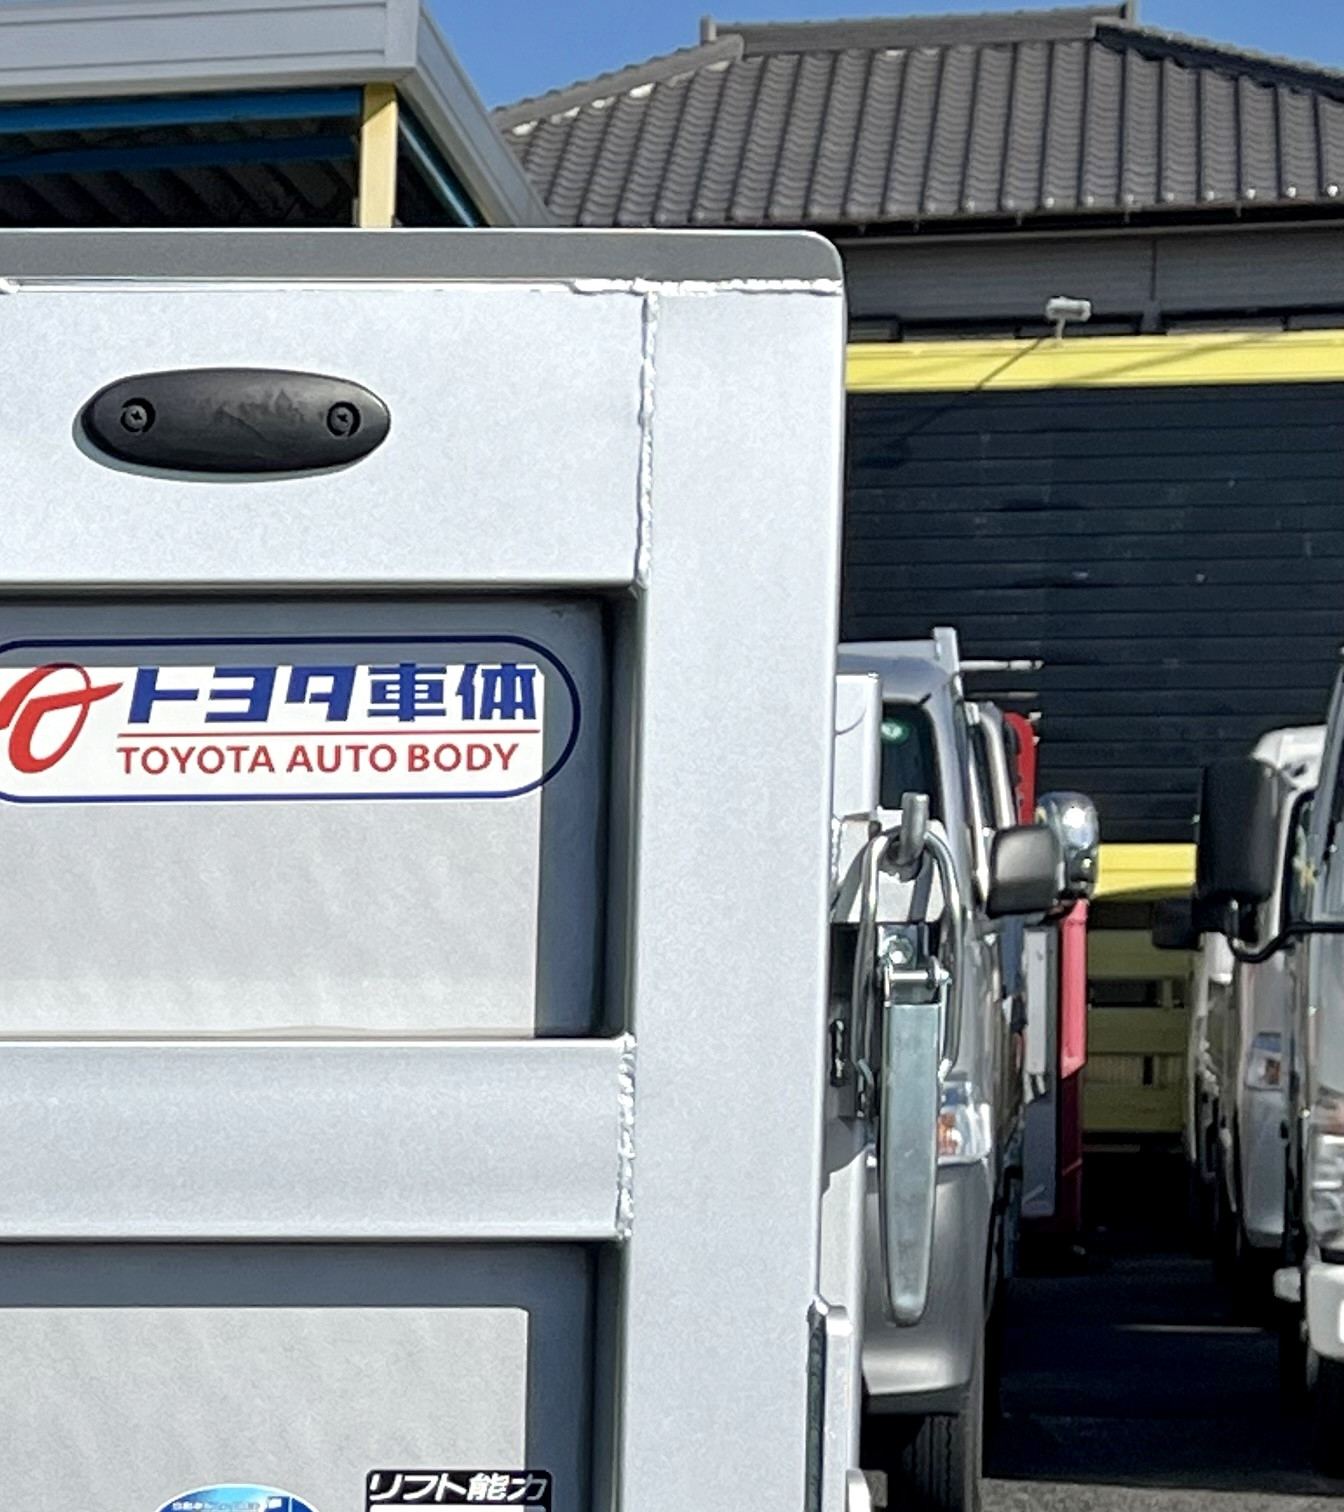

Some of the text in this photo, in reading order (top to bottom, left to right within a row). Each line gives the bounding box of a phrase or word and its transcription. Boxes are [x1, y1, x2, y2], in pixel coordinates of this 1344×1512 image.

[127, 663, 536, 723] トヨタ車体
[116, 742, 519, 774] TOYOTA AUTO BODY
[369, 1473, 548, 1501] リフト能力
